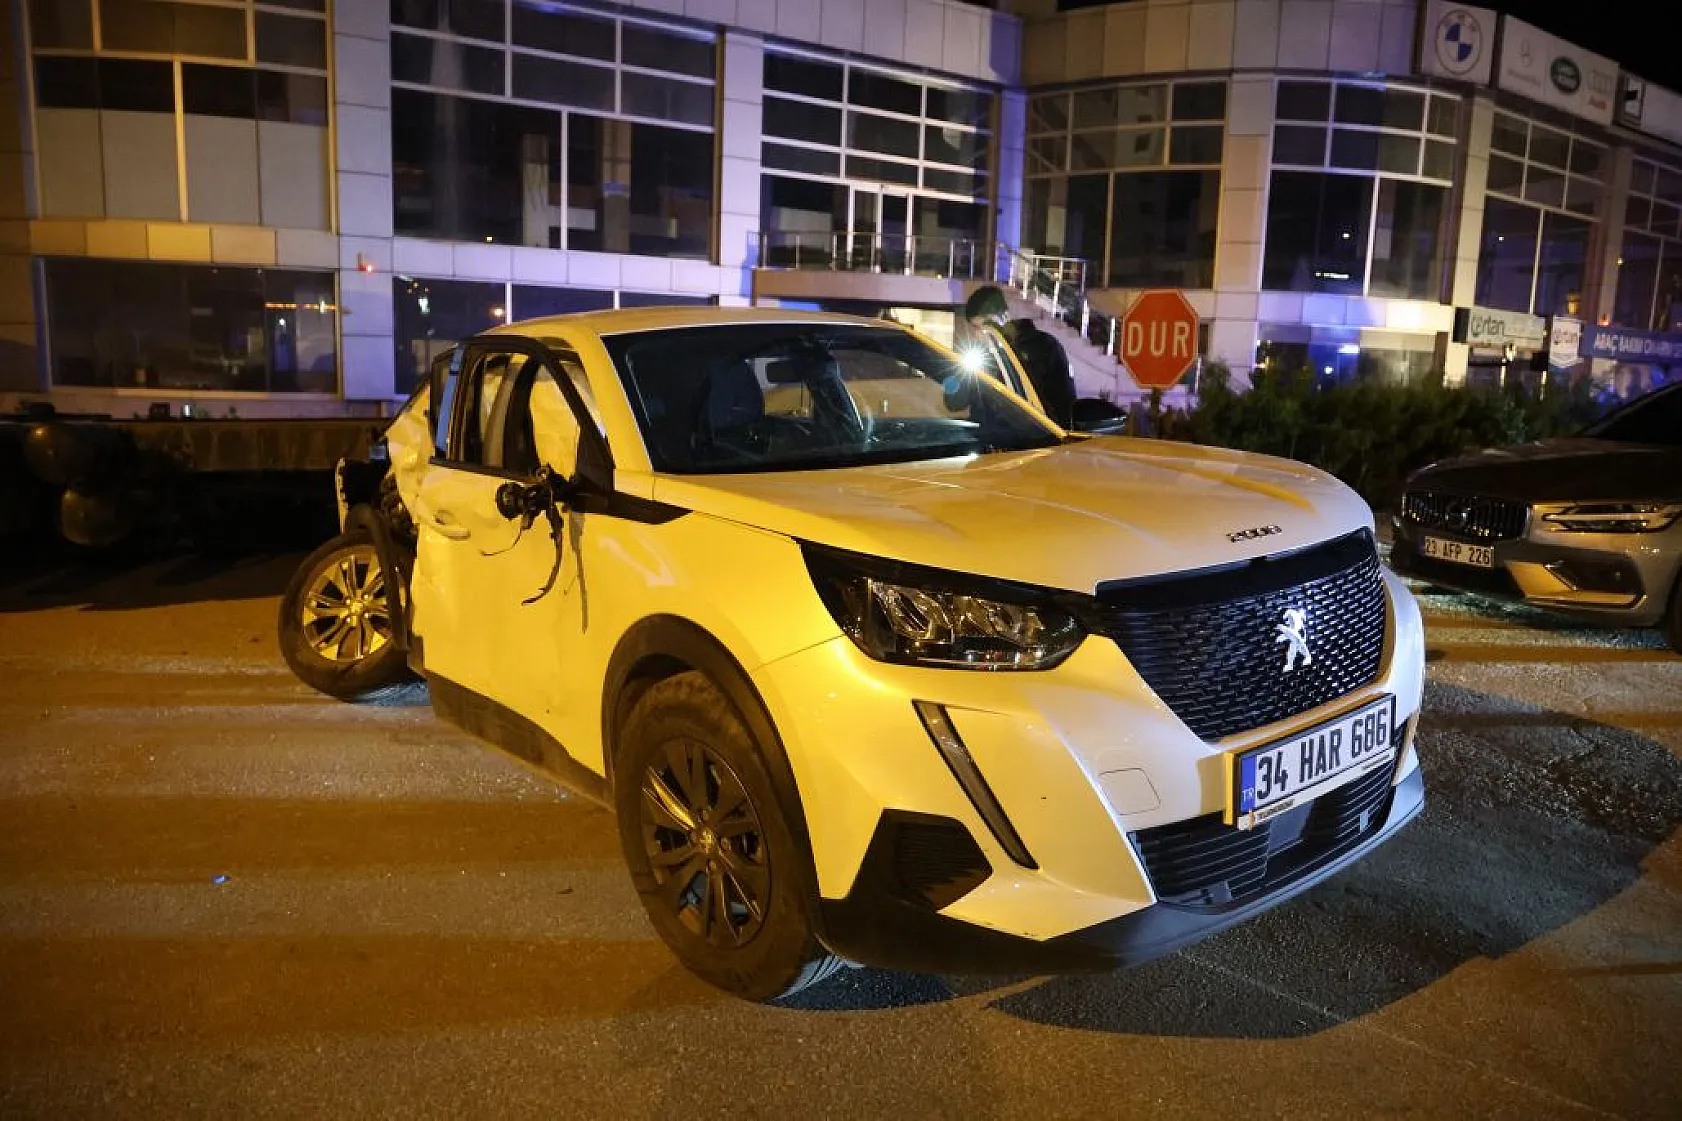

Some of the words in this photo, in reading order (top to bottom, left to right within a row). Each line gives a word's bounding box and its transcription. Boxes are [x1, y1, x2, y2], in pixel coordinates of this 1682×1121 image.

[1127, 321, 1190, 358] DUR
[1226, 525, 1282, 541] 2008
[1425, 538, 1436, 555] 23
[1443, 541, 1462, 560] AFP
[1468, 546, 1490, 565] 226
[1256, 751, 1288, 800] 34
[1299, 728, 1342, 784] HAR
[1351, 707, 1387, 759] 686
